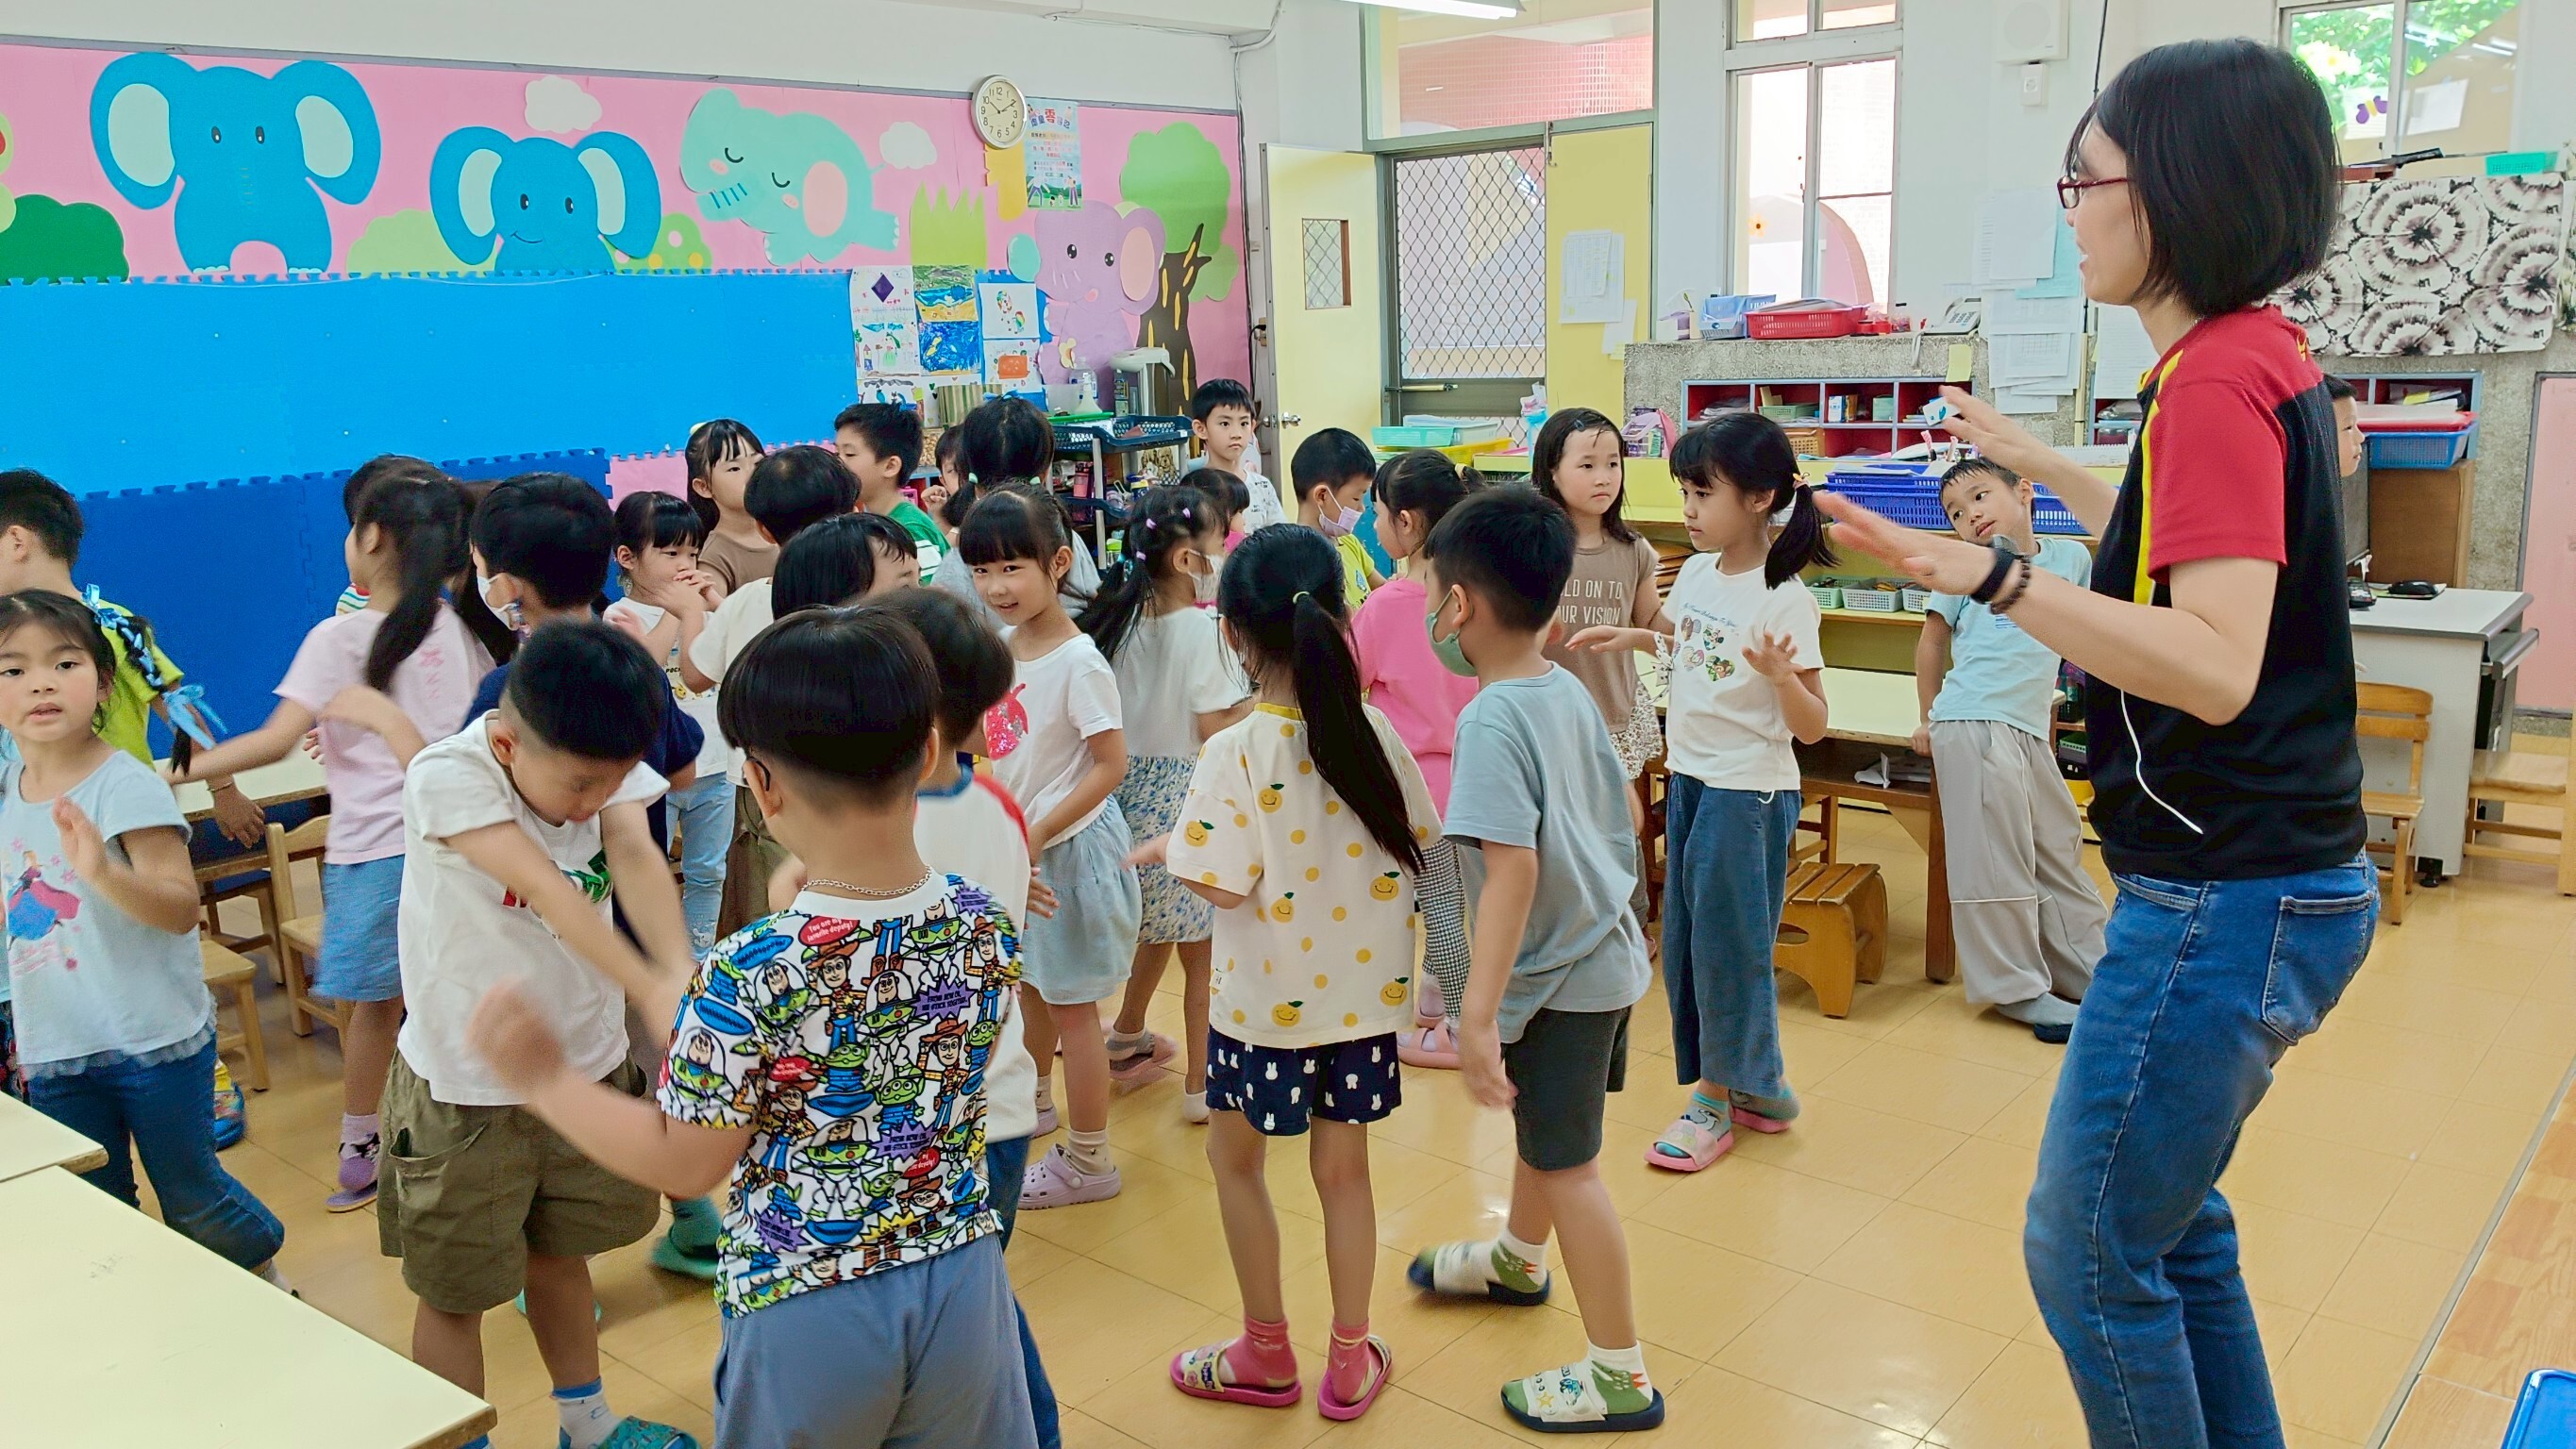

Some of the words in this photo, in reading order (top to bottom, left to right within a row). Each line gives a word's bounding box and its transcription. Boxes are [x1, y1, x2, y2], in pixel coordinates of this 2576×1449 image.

[1585, 579, 1603, 598] ON
[1608, 580, 1623, 599] TO
[1583, 606, 1621, 625] VISION
[809, 924, 821, 933] You
